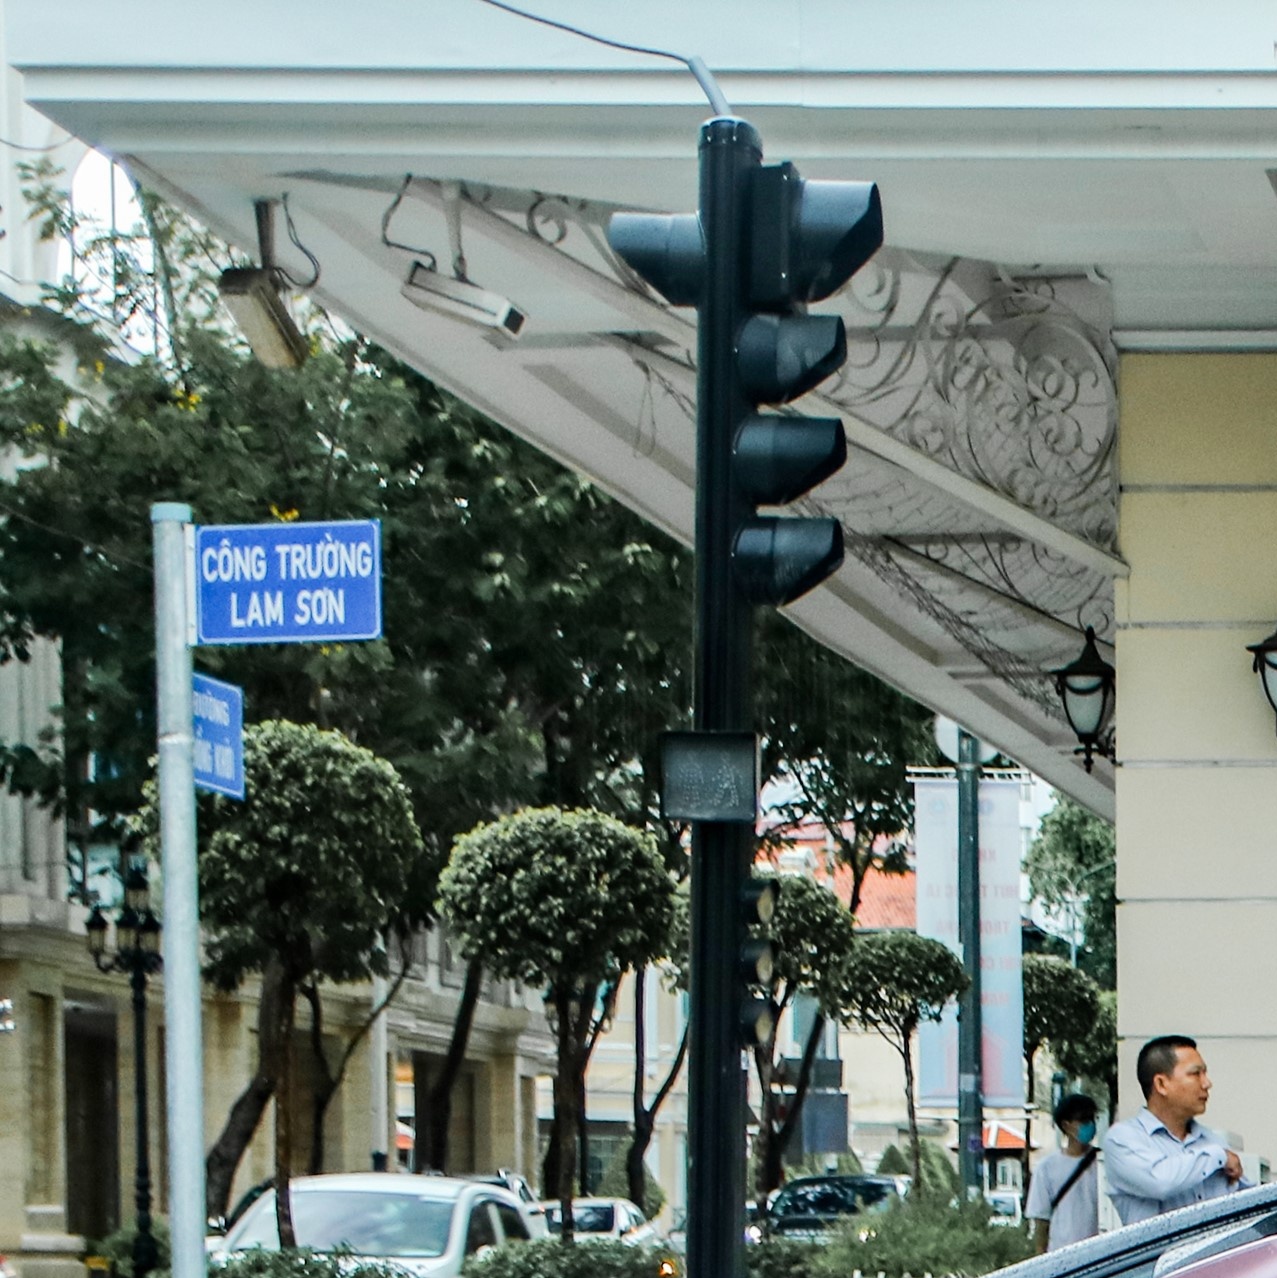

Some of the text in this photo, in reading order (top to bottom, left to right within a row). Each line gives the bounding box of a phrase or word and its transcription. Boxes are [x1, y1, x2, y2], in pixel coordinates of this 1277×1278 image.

[202, 532, 373, 584] CÔNG TRƯỜNG
[231, 586, 345, 628] LAM SƠN
